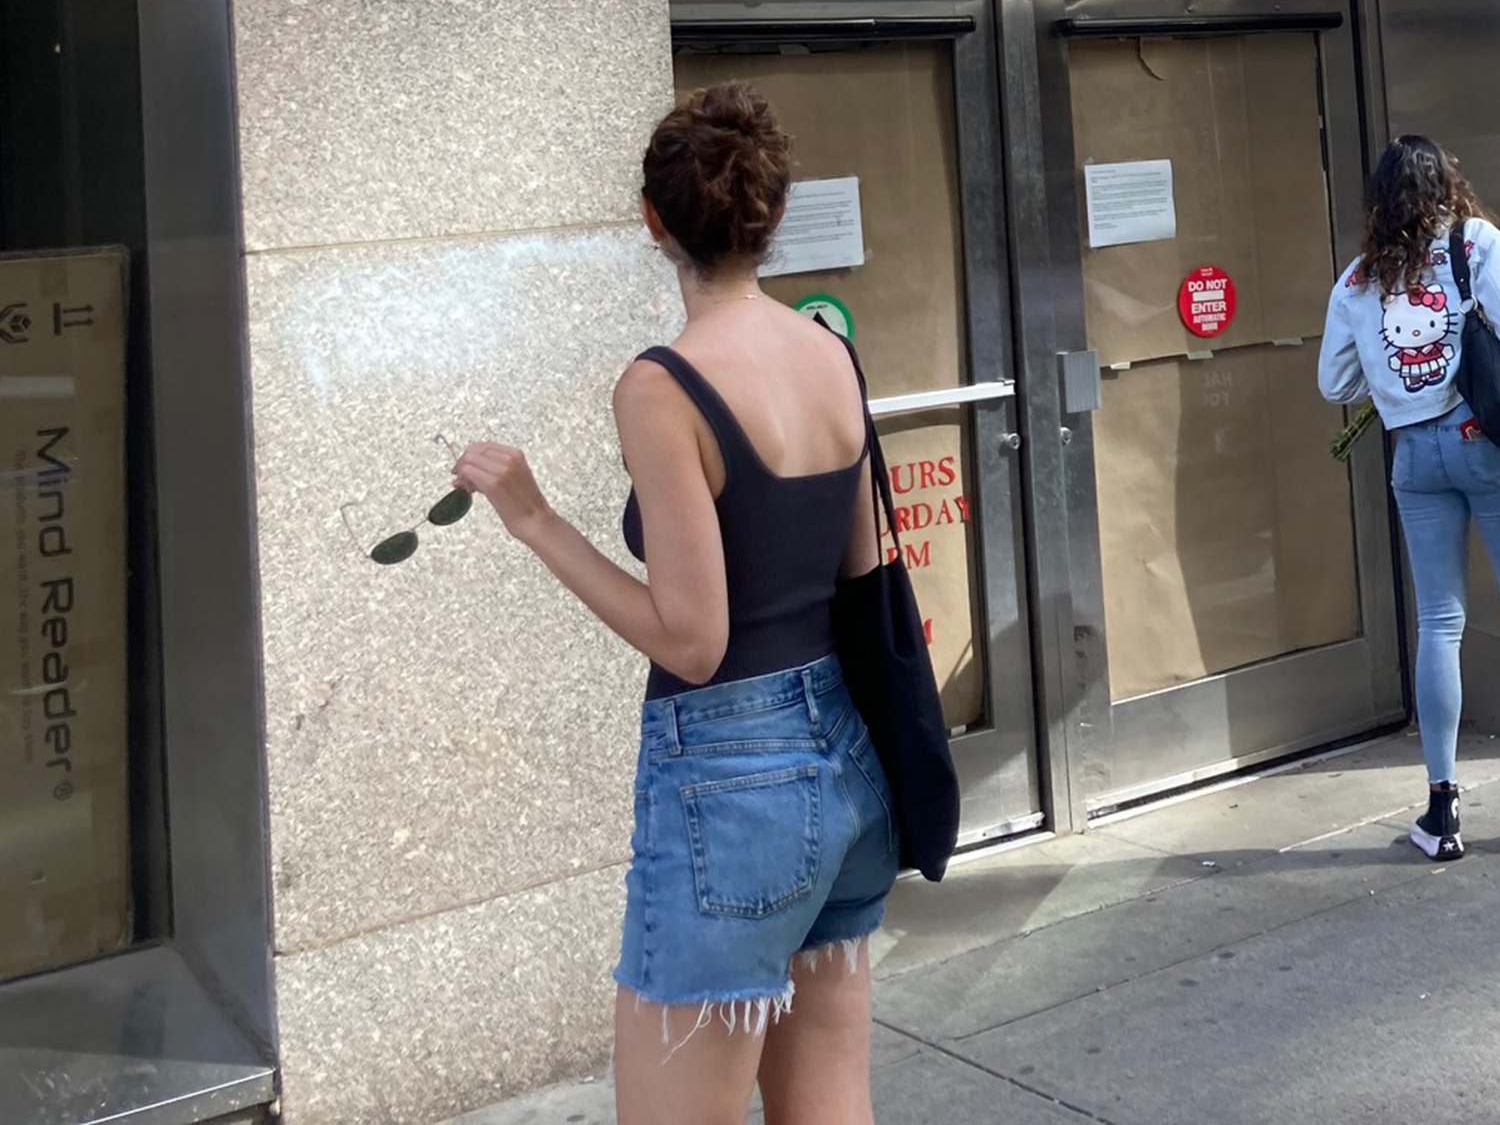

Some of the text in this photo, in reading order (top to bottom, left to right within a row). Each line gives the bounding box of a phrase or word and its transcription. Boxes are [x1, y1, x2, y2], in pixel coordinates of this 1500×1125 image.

[1188, 279, 1227, 292] DO NOT
[1191, 301, 1227, 314] ENTER
[37, 427, 73, 557] Mind
